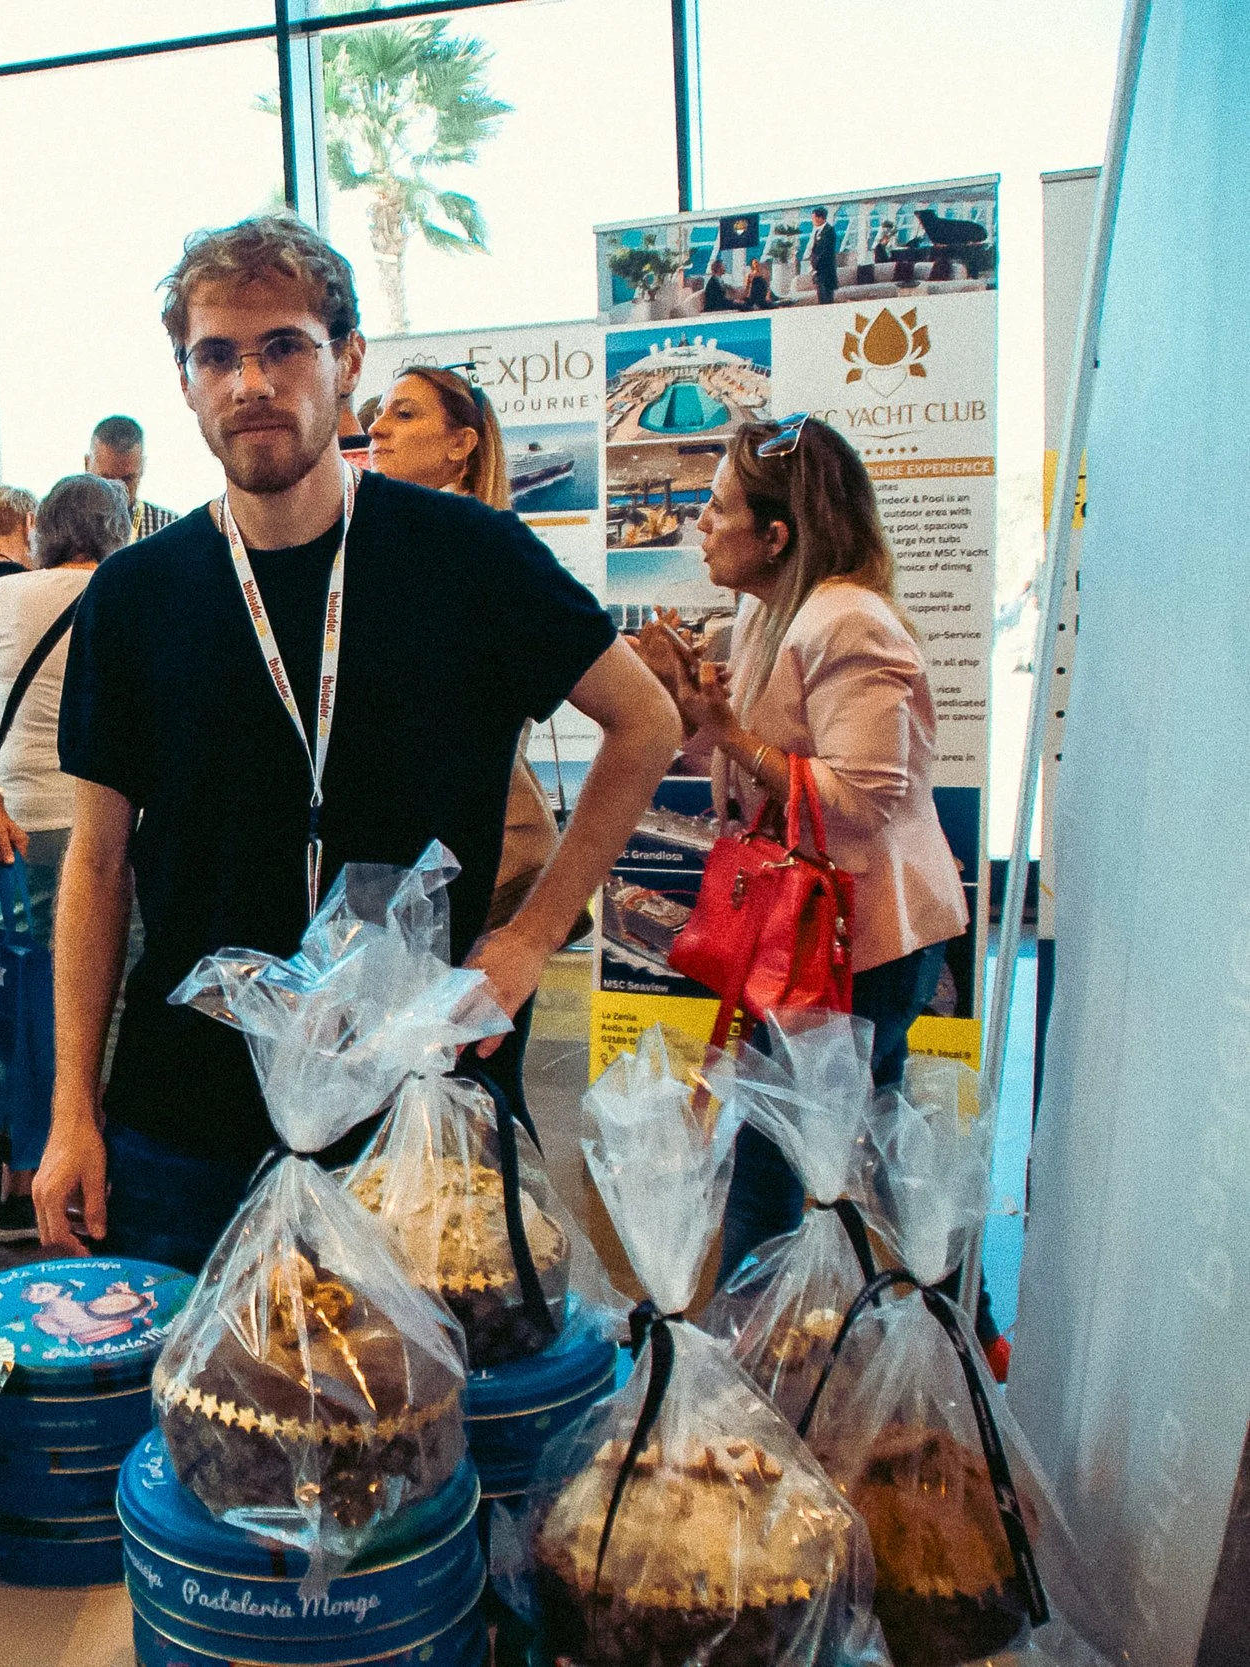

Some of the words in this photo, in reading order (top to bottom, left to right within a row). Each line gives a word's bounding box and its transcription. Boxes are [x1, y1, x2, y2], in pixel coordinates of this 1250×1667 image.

[498, 394, 599, 414] JOURNE
[846, 403, 918, 428] YACHT
[924, 400, 988, 423] CLUB
[867, 464, 904, 478] RUISE
[906, 460, 991, 476] EXPERIENCE
[921, 494, 945, 503] Pool
[934, 549, 957, 558] MSC
[960, 547, 990, 558] Yacht
[951, 603, 972, 613] and
[631, 850, 684, 862] Grandiosa
[603, 979, 627, 990] MSC
[628, 981, 669, 993] Seaview
